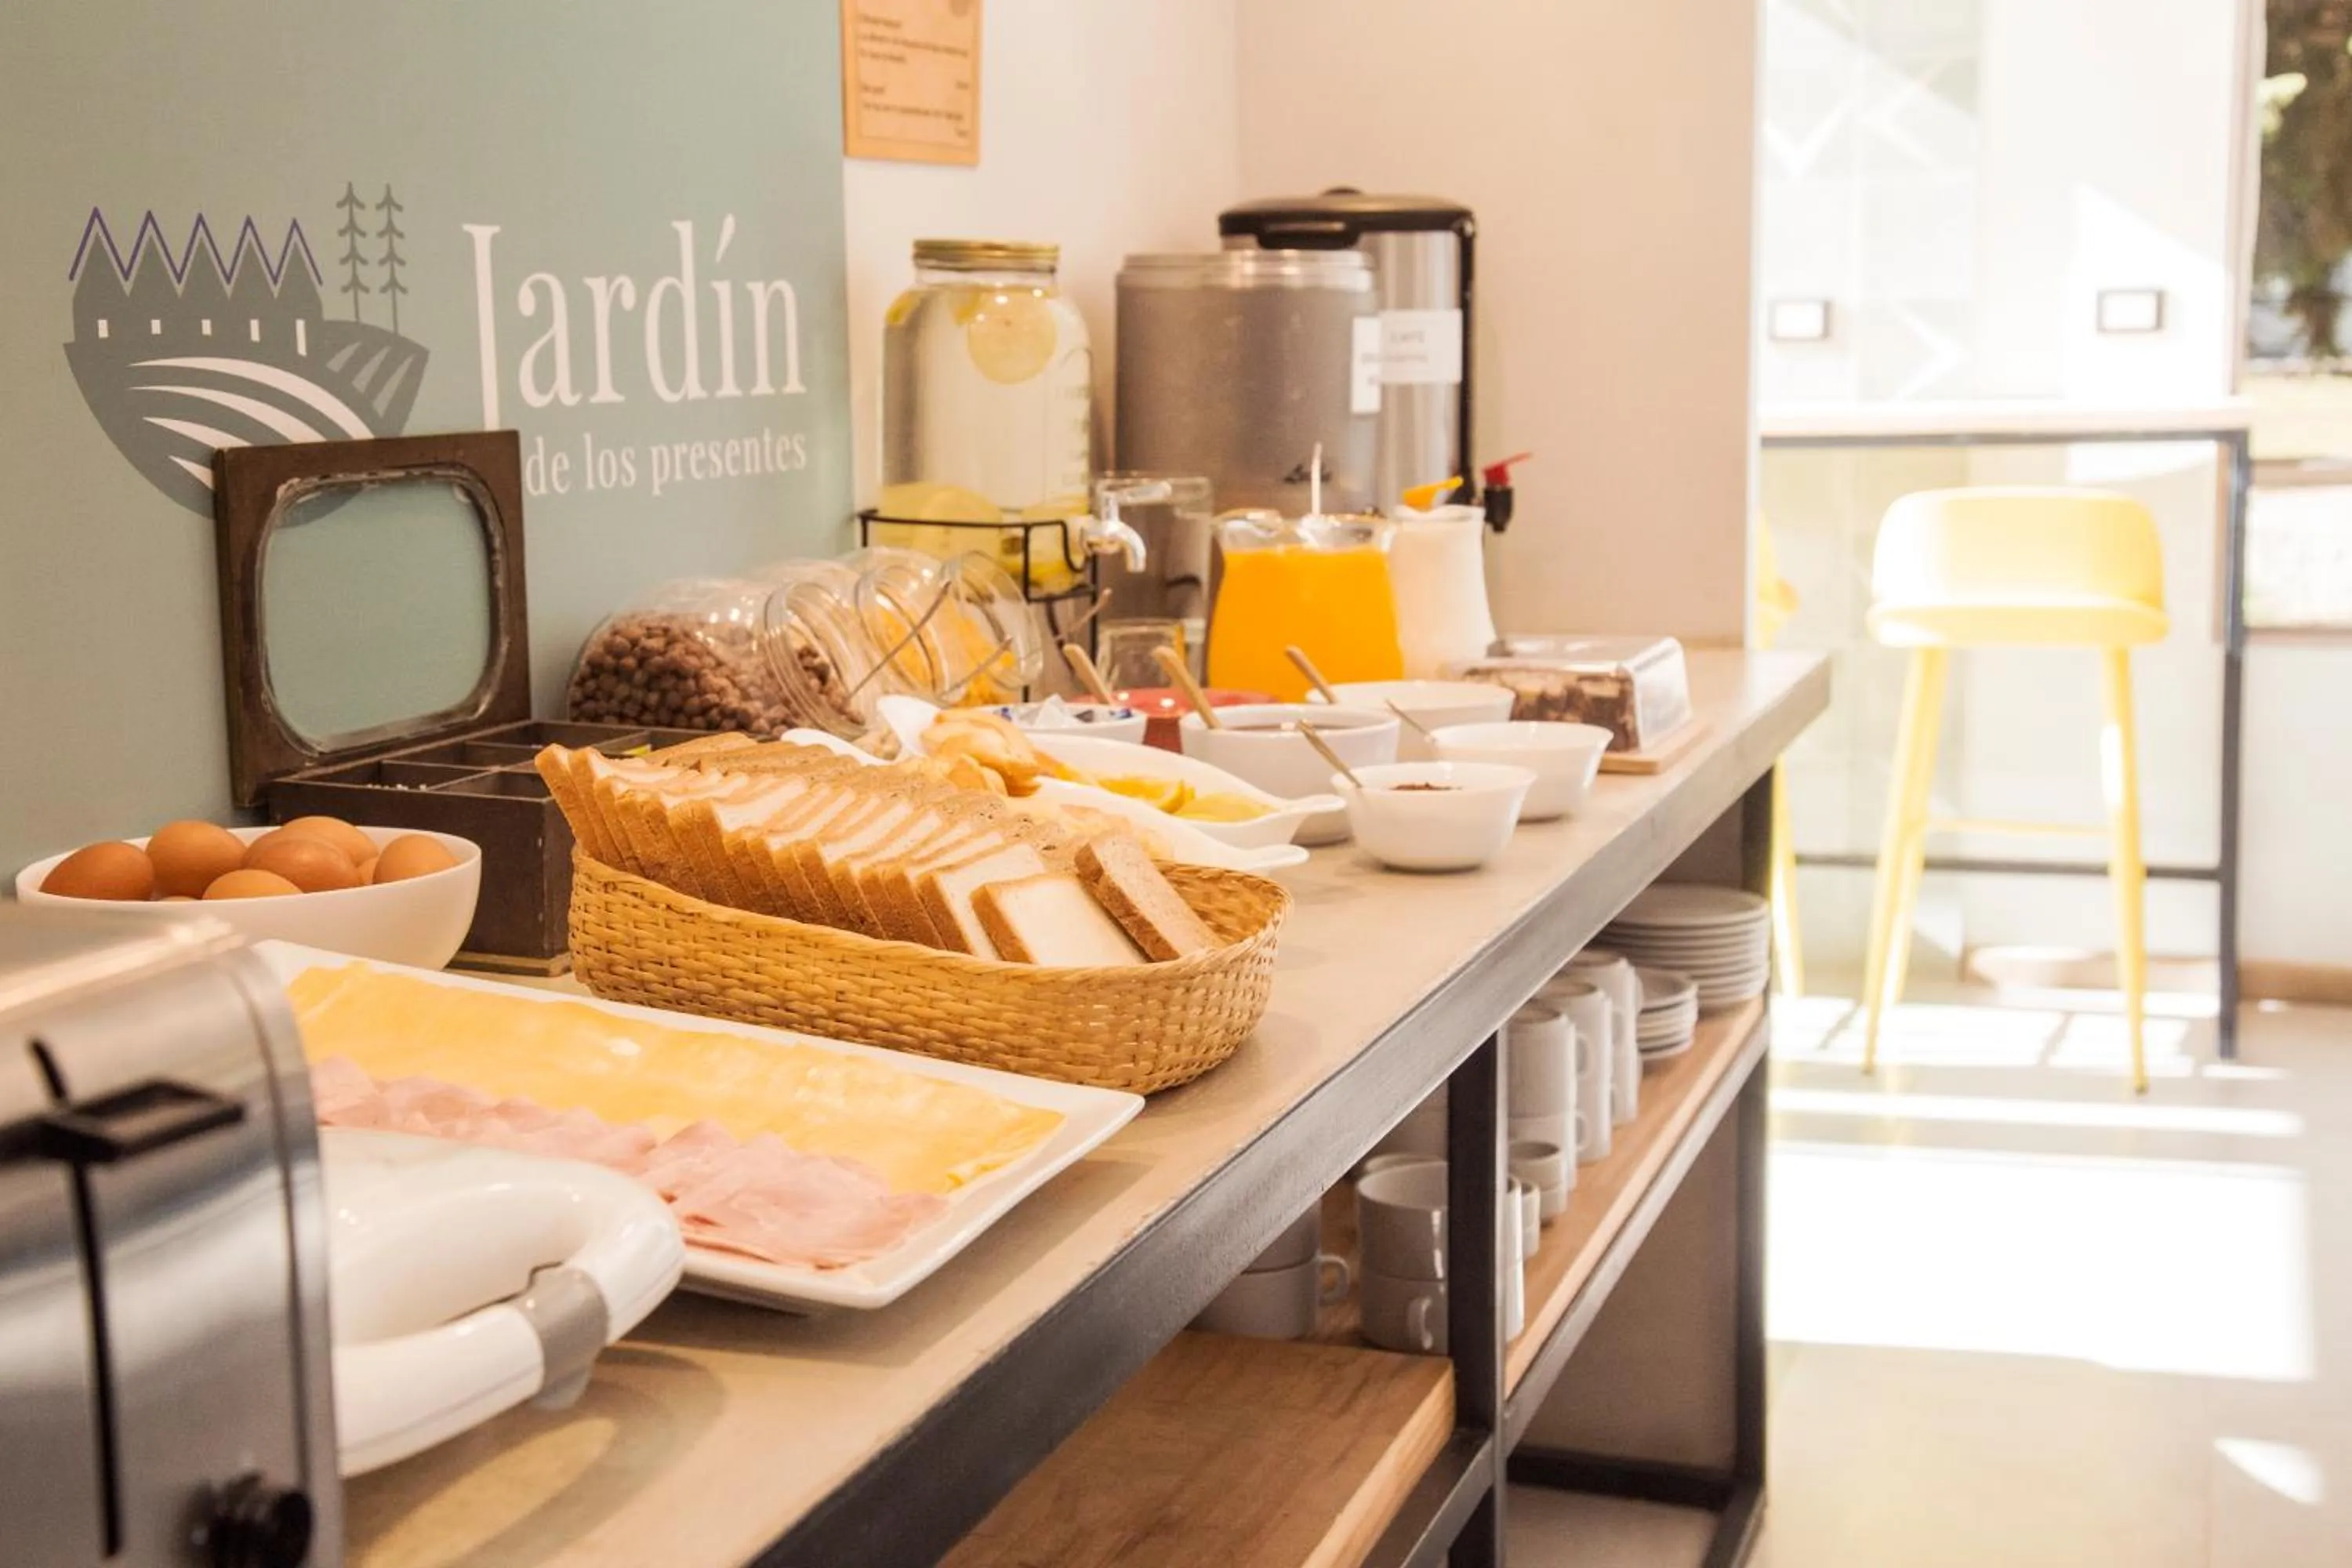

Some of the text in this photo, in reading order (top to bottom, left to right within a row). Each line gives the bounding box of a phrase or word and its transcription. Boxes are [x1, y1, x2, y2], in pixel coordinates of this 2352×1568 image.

[462, 212, 808, 430] Jardín
[526, 427, 808, 497] de los presentes
